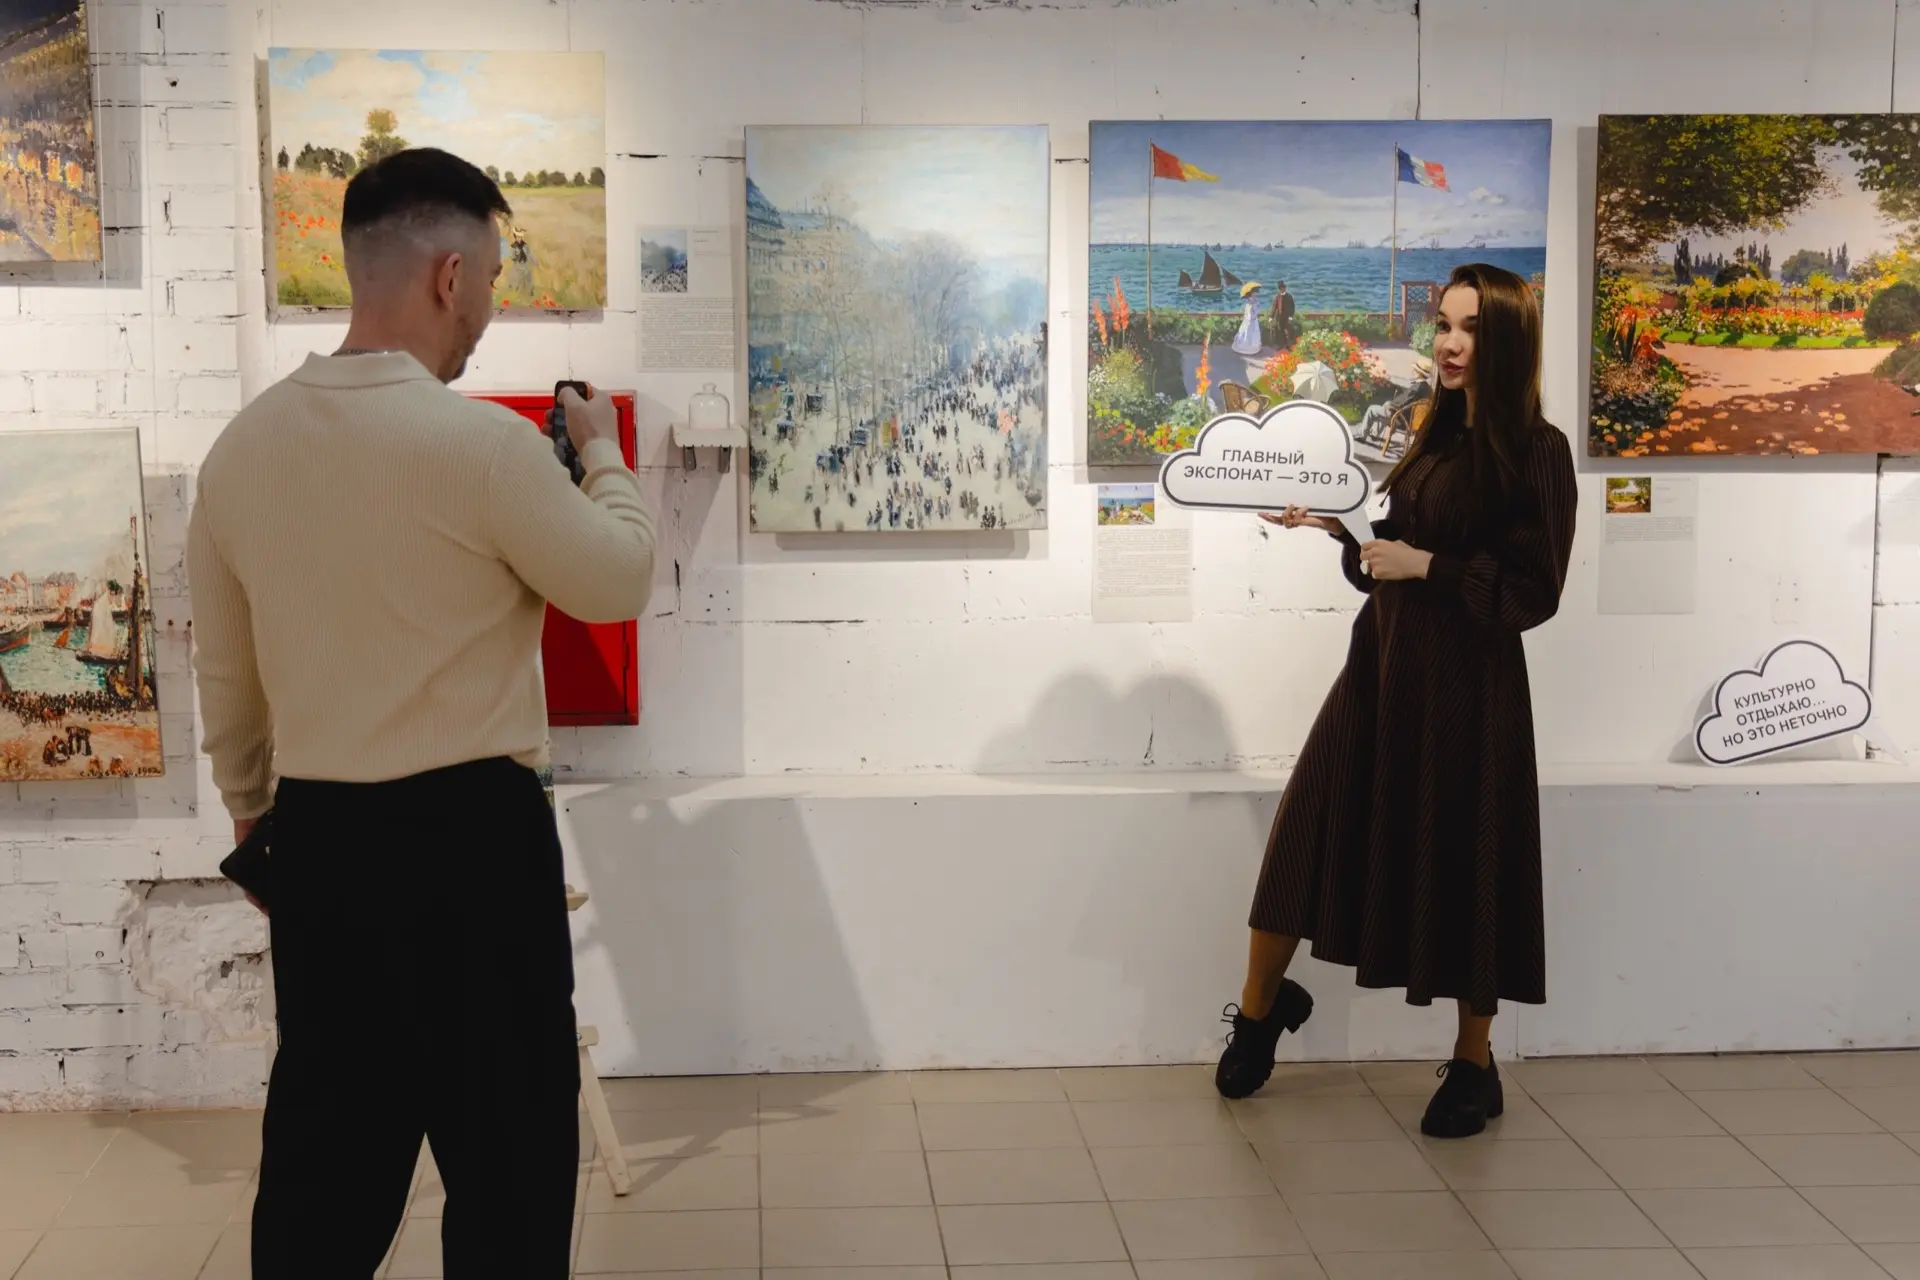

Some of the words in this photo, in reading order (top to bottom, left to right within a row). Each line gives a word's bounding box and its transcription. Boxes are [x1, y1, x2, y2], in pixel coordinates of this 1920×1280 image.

[1222, 449, 1305, 465] ГЛАВНЫЙ
[1184, 465, 1273, 482] ЭКСПОНАТ
[1299, 471, 1332, 485] ЭТО
[1336, 473, 1348, 486] Я
[1734, 678, 1816, 709] КУЛЬТУРНО
[1722, 732, 1744, 748] НО
[1747, 724, 1776, 741] ЭТО
[1779, 704, 1848, 733] НЕТОЧНО
